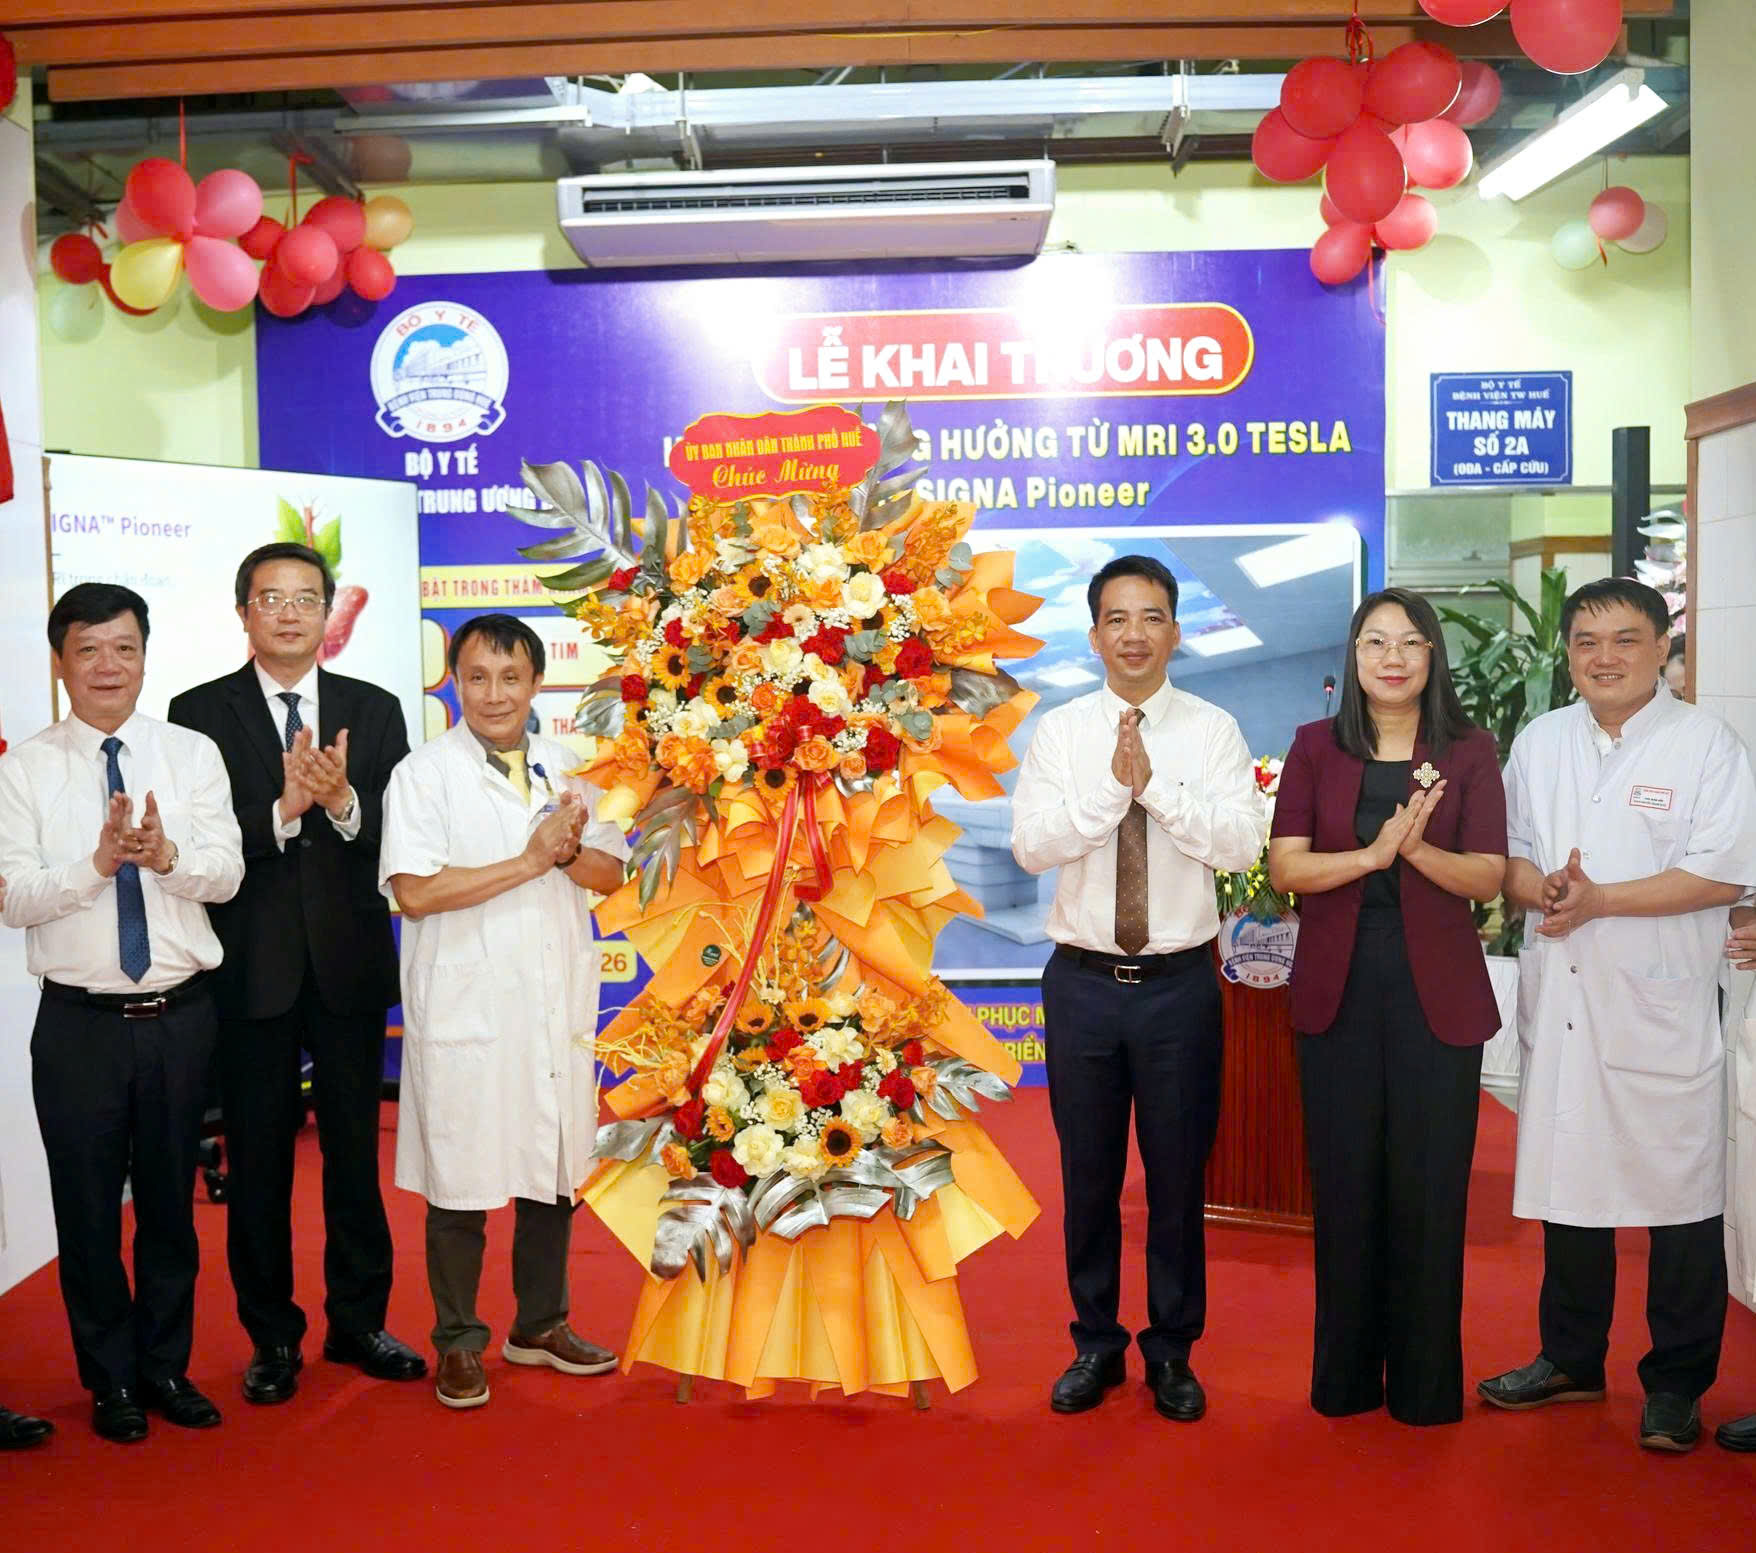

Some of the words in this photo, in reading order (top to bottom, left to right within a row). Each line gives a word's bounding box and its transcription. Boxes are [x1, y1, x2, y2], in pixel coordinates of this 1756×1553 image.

[788, 325, 849, 391] LỄ
[862, 342, 988, 389] KHAI
[1497, 381, 1505, 389] Y
[1510, 390, 1526, 399] TW
[415, 418, 467, 433] 1894
[1446, 410, 1509, 430] THANG
[1514, 406, 1556, 429] MÁY
[702, 443, 723, 460] BAN
[726, 437, 754, 458] NHÂN
[841, 427, 862, 447] HUẾ
[940, 418, 1058, 460] HƯỞNG
[1066, 417, 1110, 457] TỪ
[1117, 424, 1177, 456] MRI
[1186, 423, 1238, 455] 3.0
[1246, 421, 1352, 454] TESLA
[1473, 430, 1500, 456] SỐ
[1504, 436, 1529, 455] 2A
[404, 448, 433, 480] BỘ
[437, 451, 450, 475] Y
[454, 443, 479, 475] TẾ
[712, 463, 767, 488] Chúc
[774, 458, 839, 487] Mừng
[1493, 459, 1517, 474] CẤP
[915, 476, 1018, 509] SIGNA
[1027, 475, 1151, 508] Pioneer
[120, 516, 192, 538] Pioneer
[453, 581, 498, 596] TRONG
[551, 643, 578, 659] TIM
[978, 1006, 1031, 1030] PHỤC
